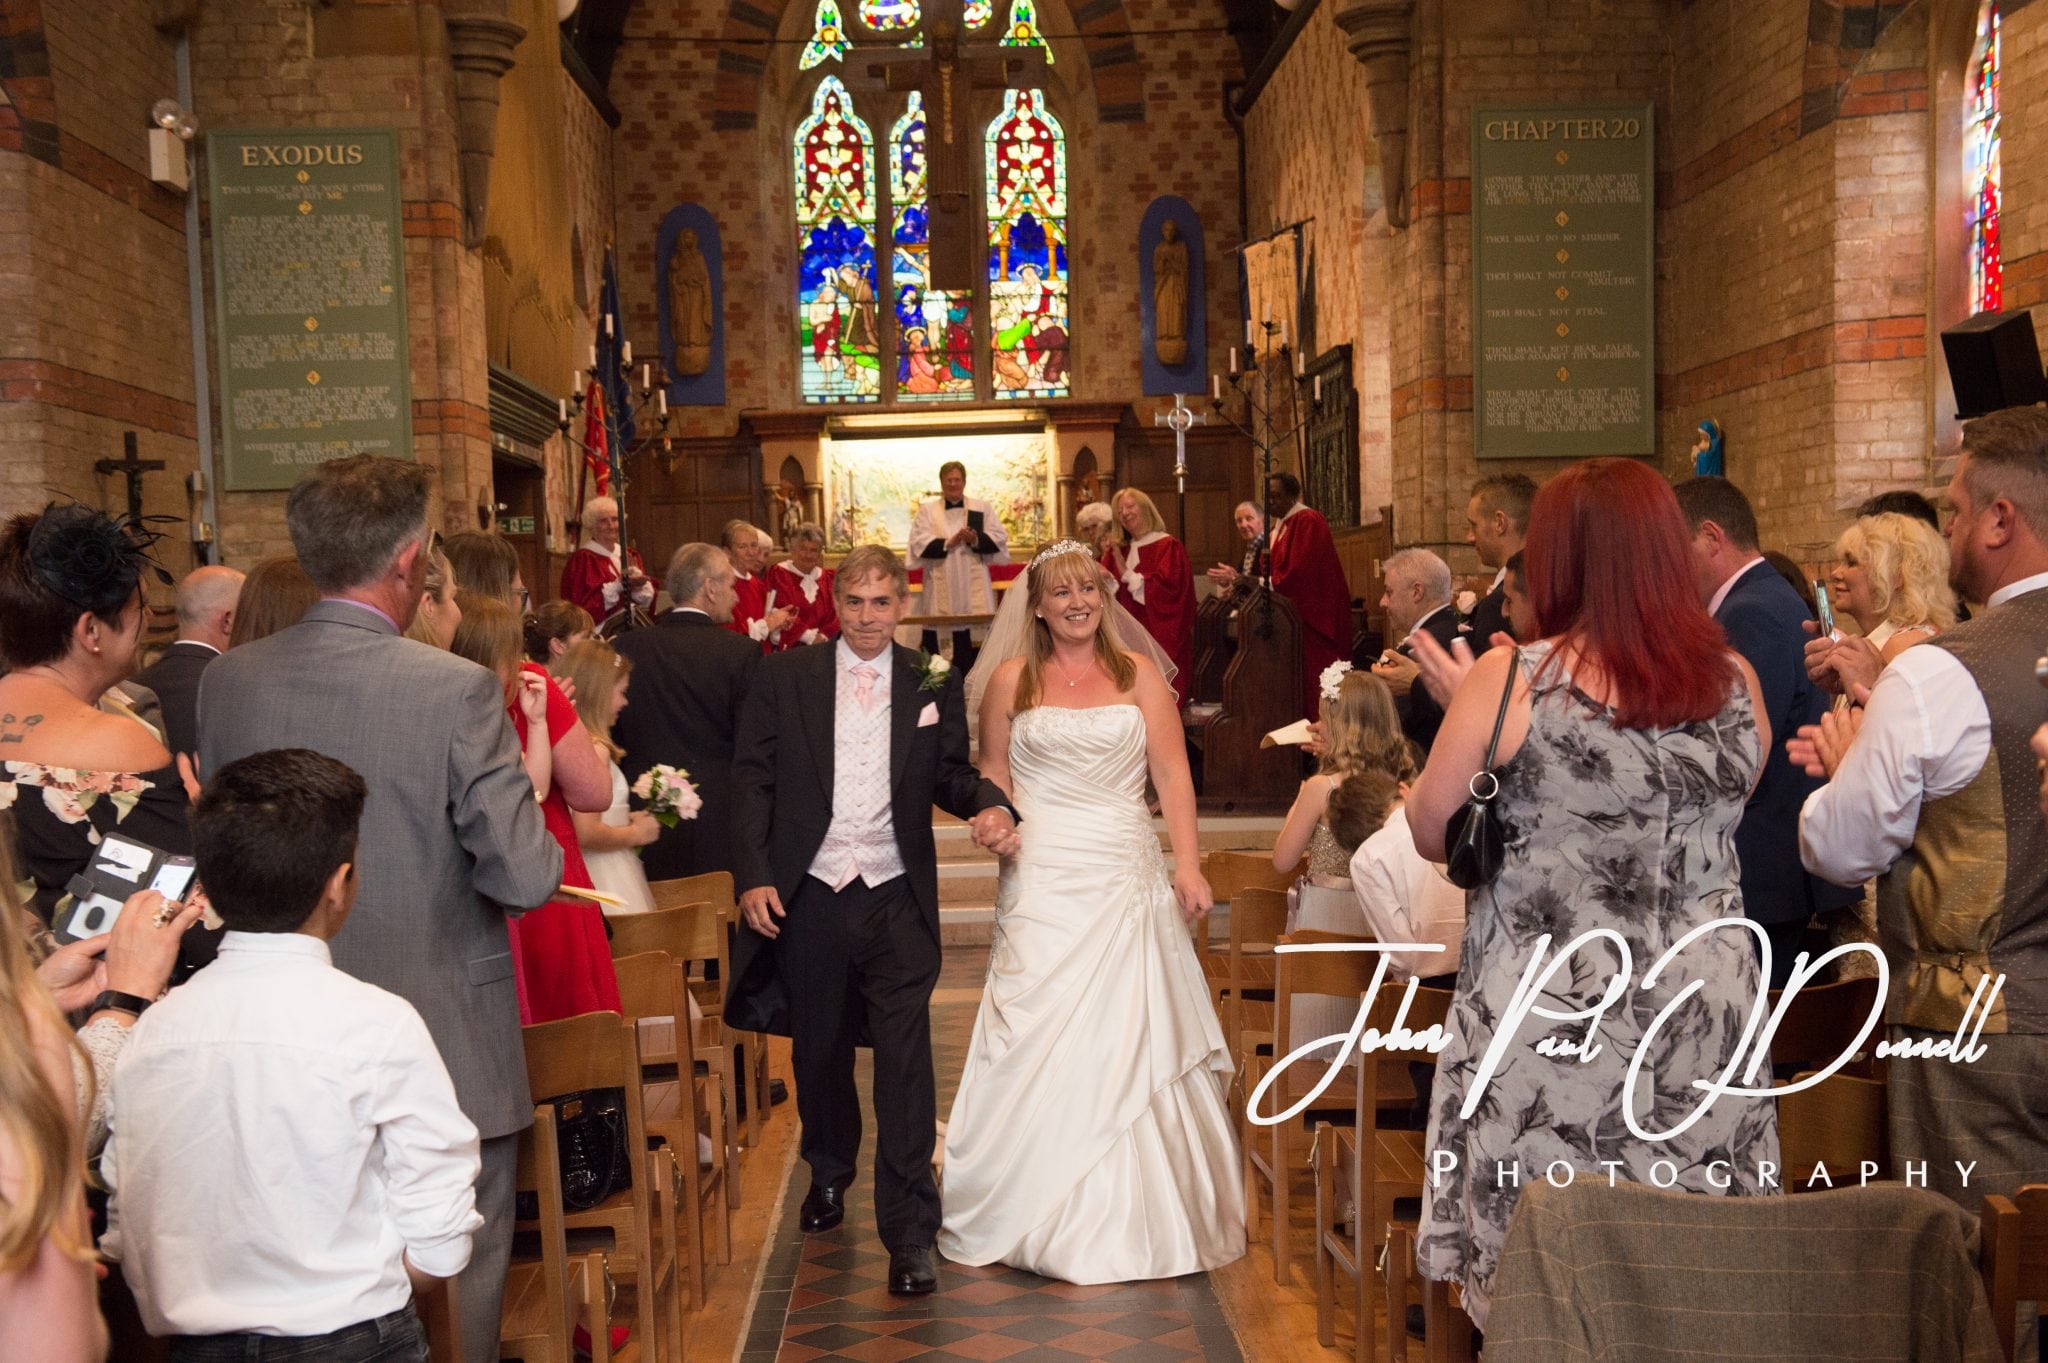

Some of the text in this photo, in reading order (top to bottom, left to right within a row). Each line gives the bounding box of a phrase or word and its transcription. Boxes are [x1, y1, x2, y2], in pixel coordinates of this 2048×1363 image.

[1485, 118, 1641, 141] CHAPTER 20
[241, 144, 363, 166] EXODUS
[1486, 235, 1509, 244] THOU
[1514, 234, 1540, 243] SHALT
[1545, 234, 1558, 242] DO
[1563, 234, 1576, 242] NO
[1486, 270, 1613, 281] THOU SHALT NOT COMMIT
[1487, 308, 1510, 318] THOU
[1514, 308, 1543, 317] SHALT
[1549, 308, 1570, 317] NOT
[1486, 345, 1511, 354] THOU
[1515, 345, 1545, 353] SHALT
[1550, 345, 1571, 353] NOT
[1485, 353, 1525, 361] WITNESS
[1528, 352, 1568, 361] AGAINST
[1571, 352, 1588, 360] THY
[1486, 386, 1639, 398] THOU SHALT NOT COVET THY
